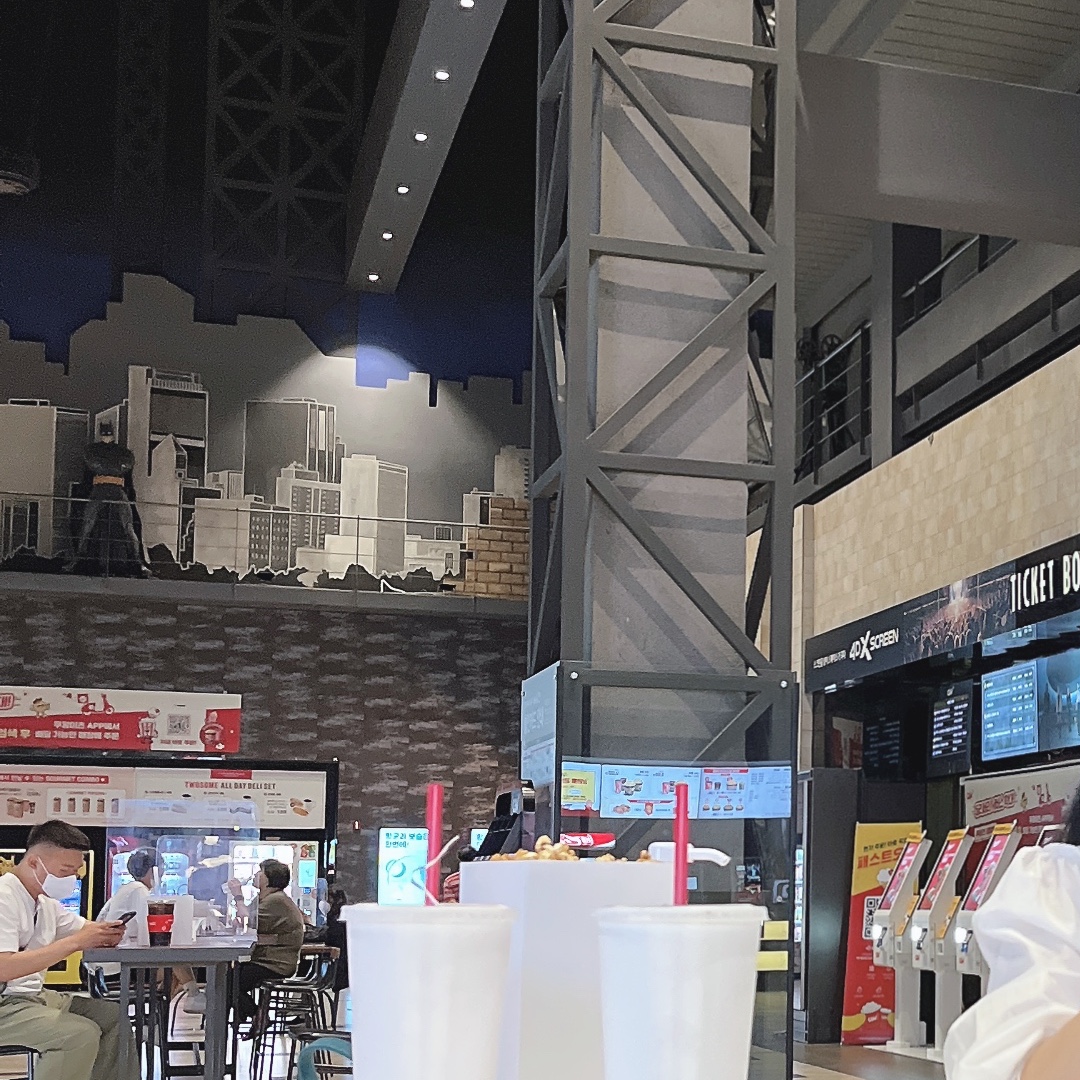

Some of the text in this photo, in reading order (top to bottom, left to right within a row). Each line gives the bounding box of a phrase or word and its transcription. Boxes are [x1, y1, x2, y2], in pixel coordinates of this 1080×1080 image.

[1010, 559, 1055, 613] TICKET
[184, 781, 219, 789] TWOSOME
[857, 846, 905, 869] 패스트오
